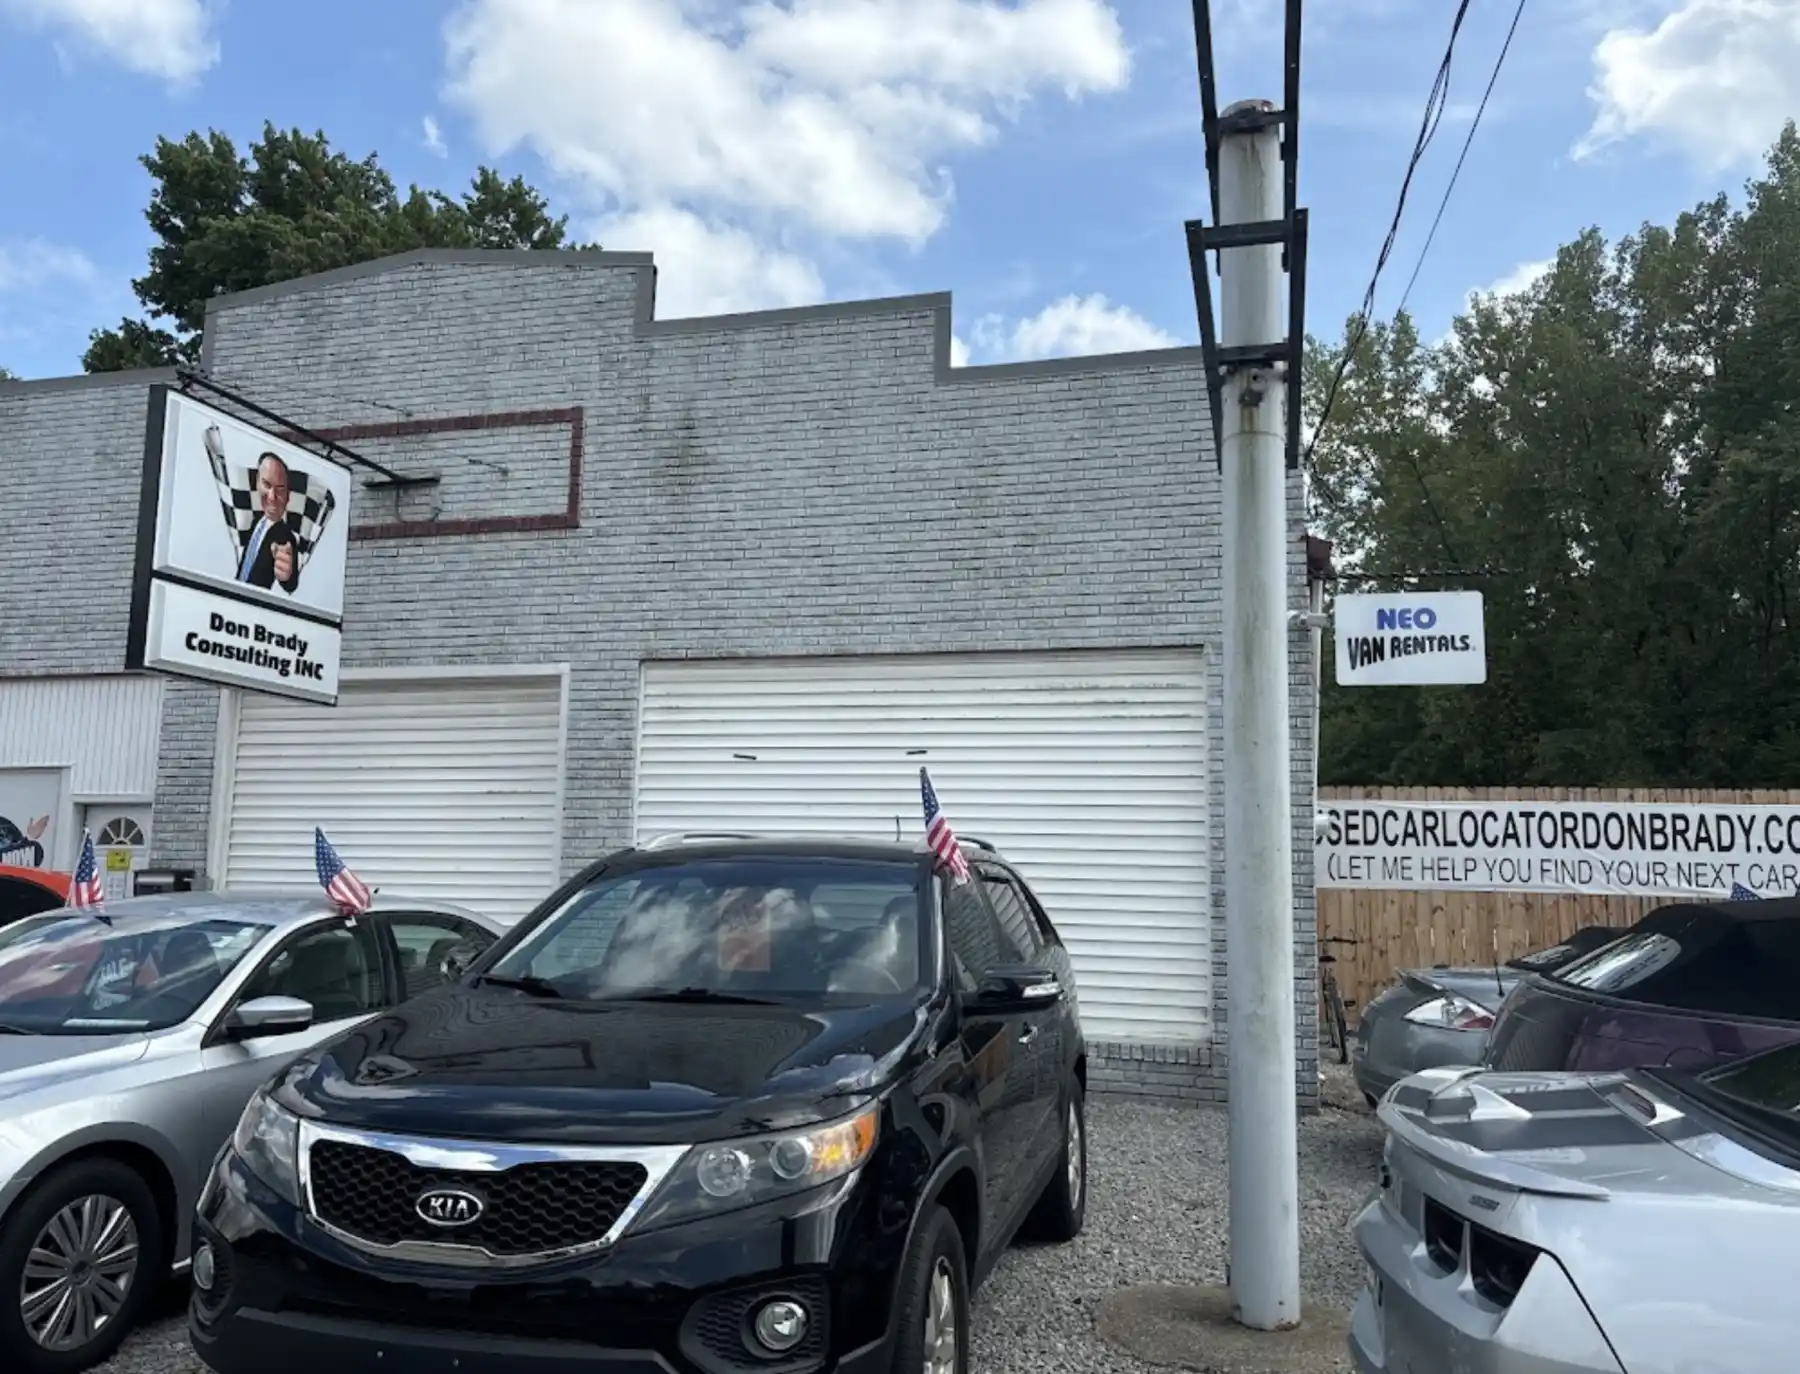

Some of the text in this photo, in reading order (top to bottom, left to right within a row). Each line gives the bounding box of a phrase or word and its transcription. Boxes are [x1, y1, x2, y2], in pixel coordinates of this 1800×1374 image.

[209, 612, 308, 657] Don Brady
[1376, 607, 1437, 630] NEO
[185, 632, 291, 677] Consulting
[1347, 635, 1385, 670] VAN
[1327, 852, 1799, 890] (LET ME HELP YOU FIND YOUR NEXT CAR
[428, 1197, 470, 1218] KIA
